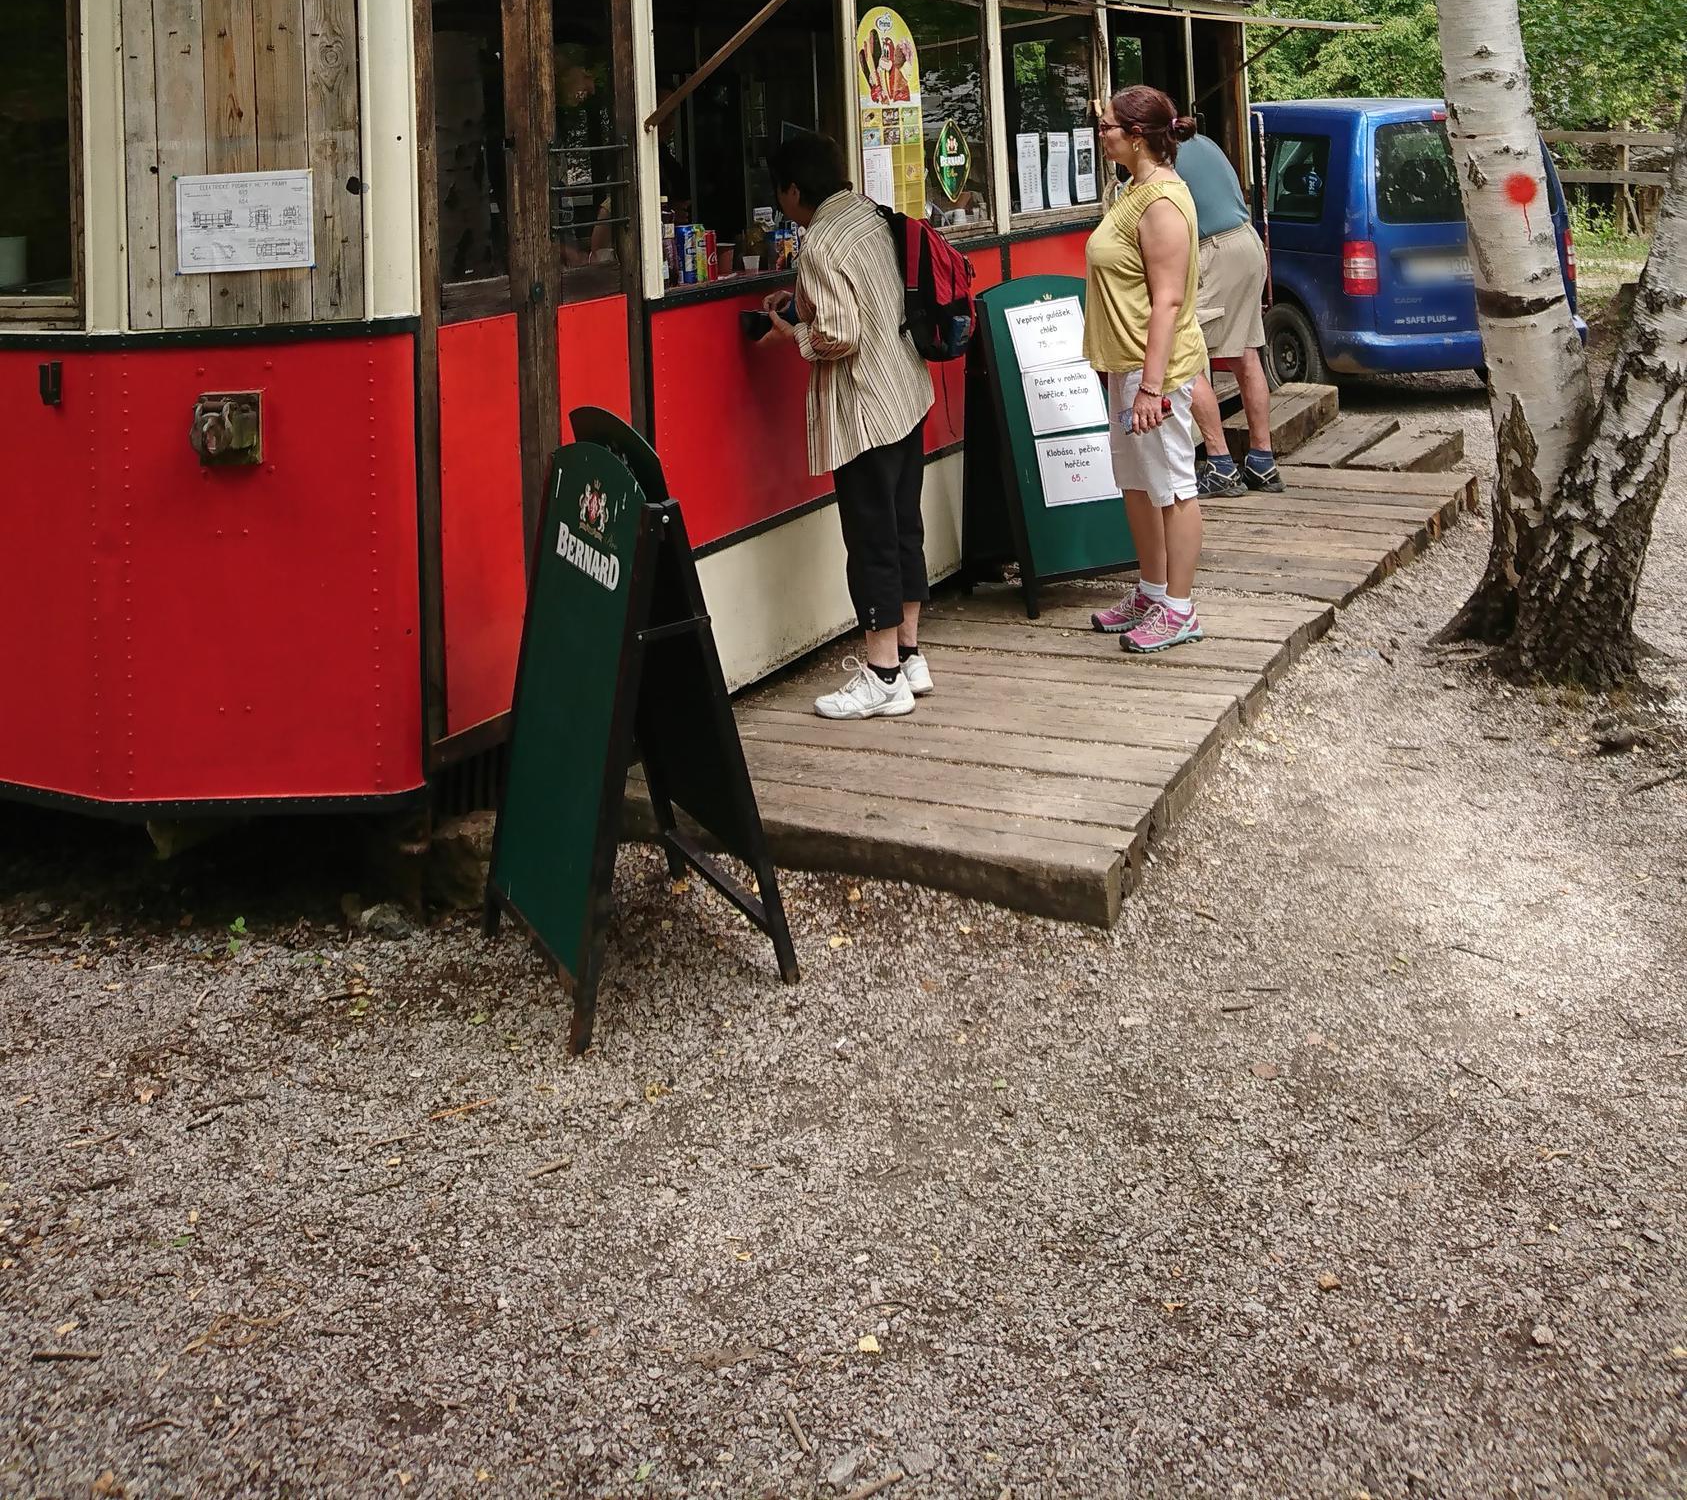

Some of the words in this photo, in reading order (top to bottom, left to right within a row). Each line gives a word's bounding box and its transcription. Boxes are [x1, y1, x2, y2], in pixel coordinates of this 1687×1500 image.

[1016, 313, 1043, 326] Vepřový
[1406, 316, 1426, 325] SAFE
[1427, 314, 1447, 323] PLUS
[1040, 326, 1057, 334] chléb
[1034, 376, 1056, 386] Párek
[1064, 373, 1087, 382] rohlíku
[1038, 390, 1067, 400] hořčice,
[1046, 448, 1076, 458] Klobása,
[1079, 444, 1103, 456] pečivo,
[1064, 460, 1091, 469] hořčice
[1071, 474, 1088, 482] 65,-
[556, 521, 620, 591] BERNARD
